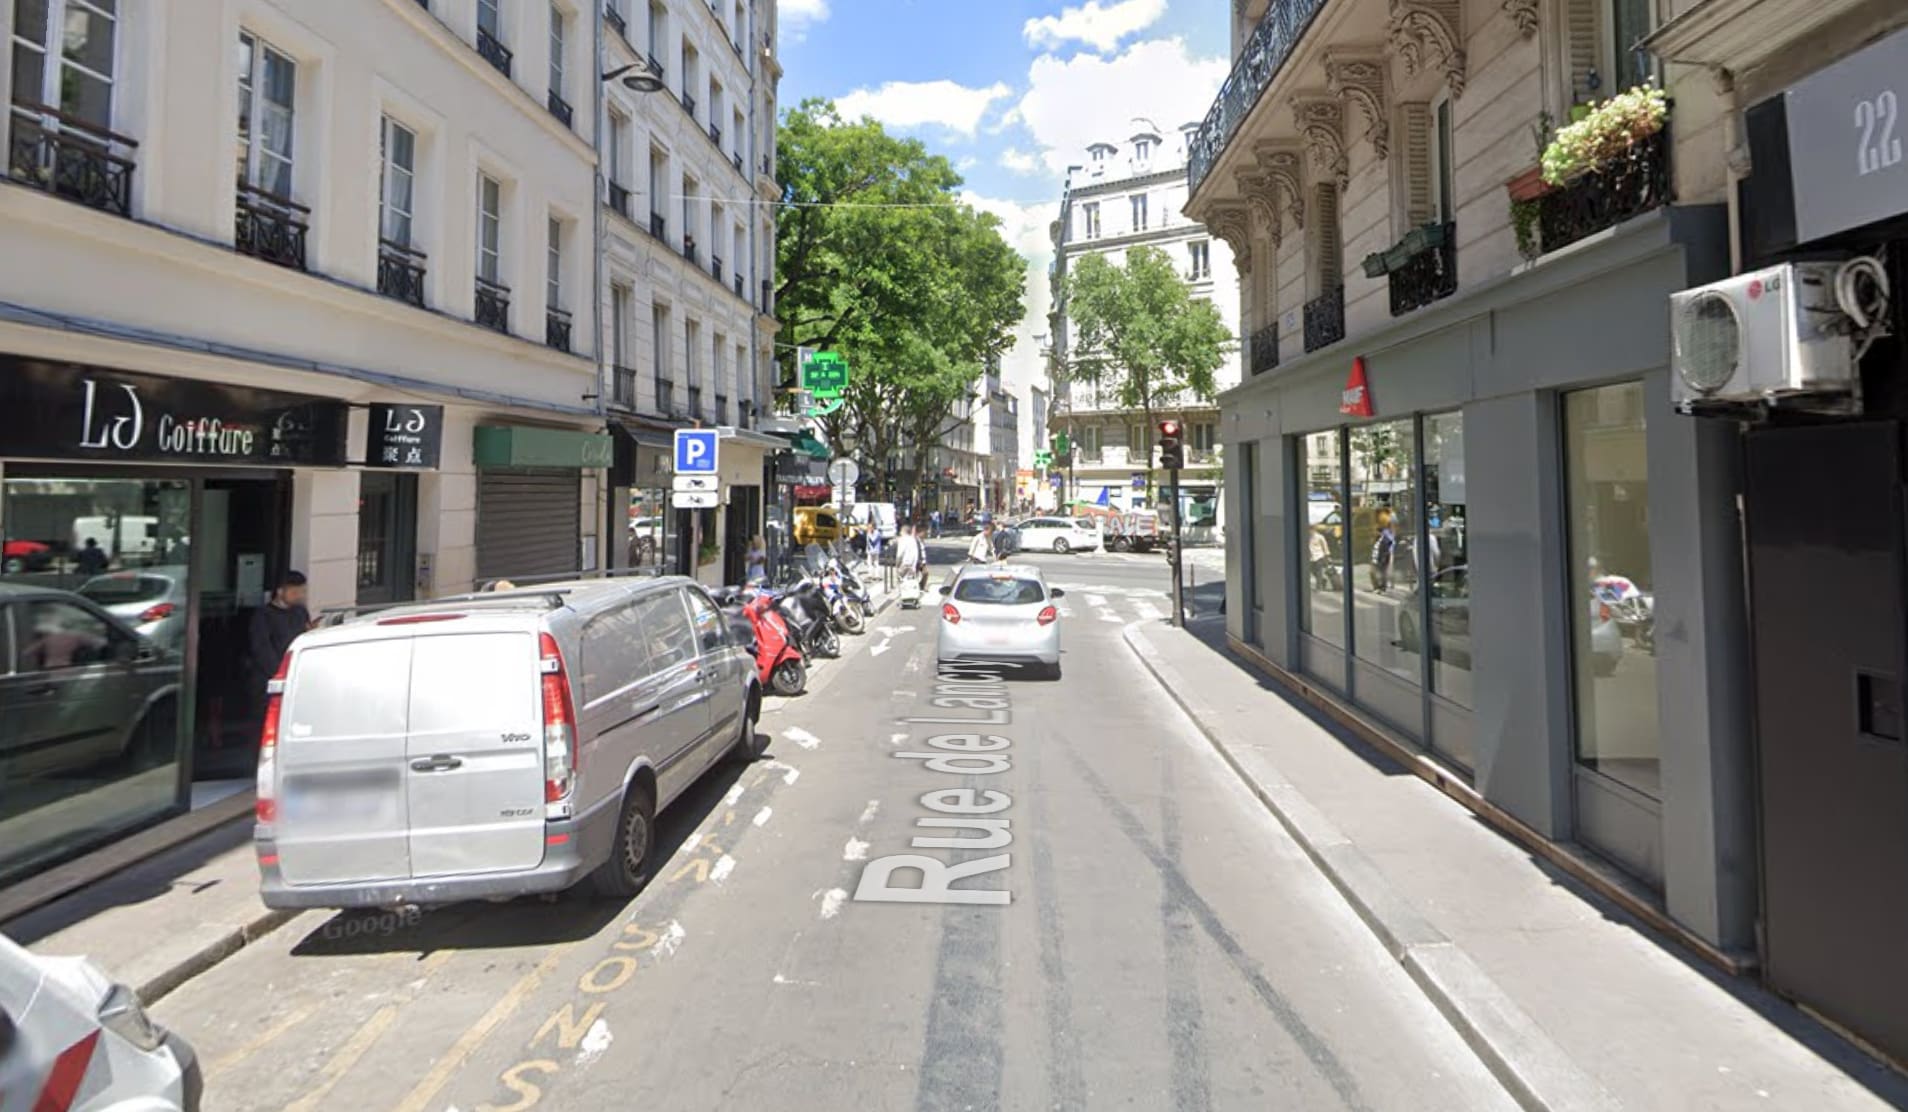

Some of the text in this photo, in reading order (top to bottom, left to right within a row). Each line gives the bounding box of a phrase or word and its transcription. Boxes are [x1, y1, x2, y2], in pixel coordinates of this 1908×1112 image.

[1855, 90, 1902, 175] 22
[1765, 278, 1781, 292] LG
[158, 414, 253, 455] Coiffure
[686, 438, 706, 465] P
